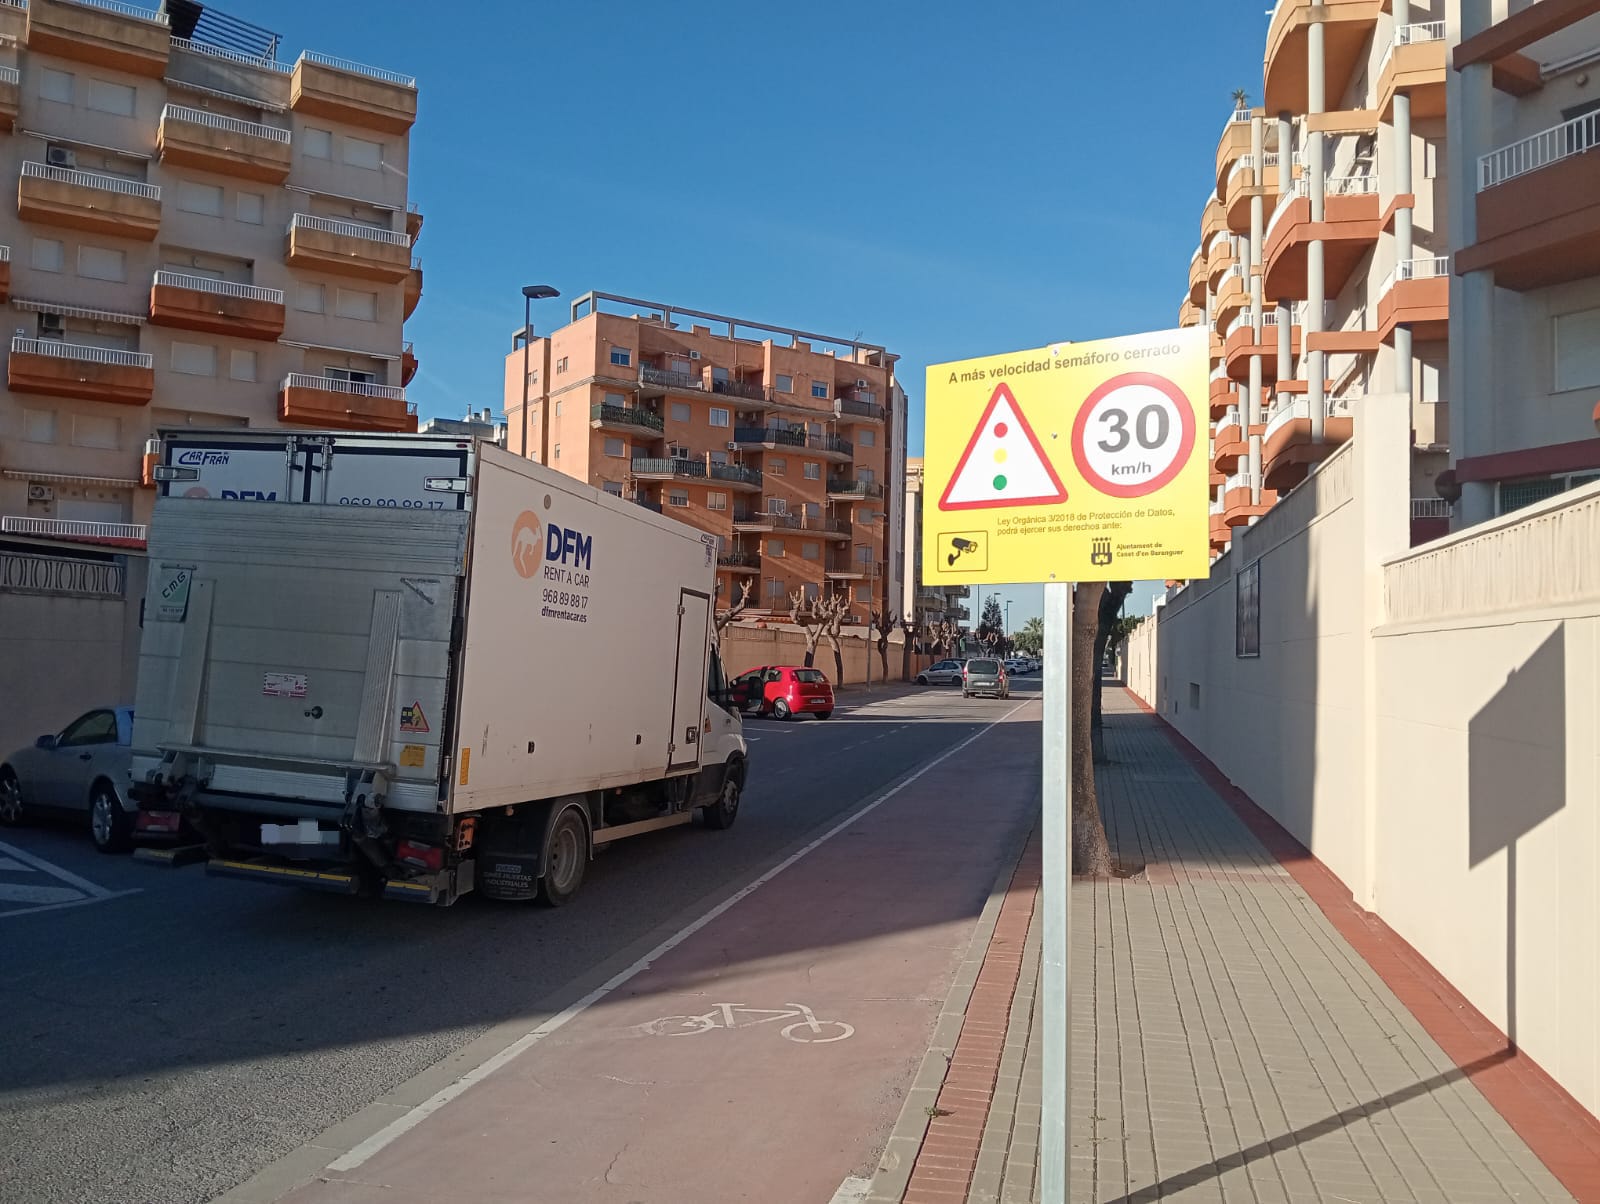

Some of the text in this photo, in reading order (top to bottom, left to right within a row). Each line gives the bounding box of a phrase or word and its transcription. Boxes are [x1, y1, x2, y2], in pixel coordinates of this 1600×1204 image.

[948, 344, 1181, 385] A más velocidad semáforo cerrado
[1097, 404, 1170, 453] 30
[1111, 461, 1152, 476] km/h
[997, 517, 1011, 527] Ley
[1012, 515, 1047, 526] Orgánica
[1076, 513, 1087, 521] de
[1089, 510, 1132, 520] Protección
[1134, 509, 1145, 518] de
[1147, 508, 1175, 517] Datos,
[1020, 526, 1046, 535] ejercer
[1063, 522, 1099, 532] derechos
[1102, 521, 1122, 530] ante:
[545, 523, 592, 570] DFM
[544, 566, 590, 589] RENT A CAR
[542, 588, 589, 610] 968 89 88 17
[541, 605, 587, 623] dfmrentacar.es
